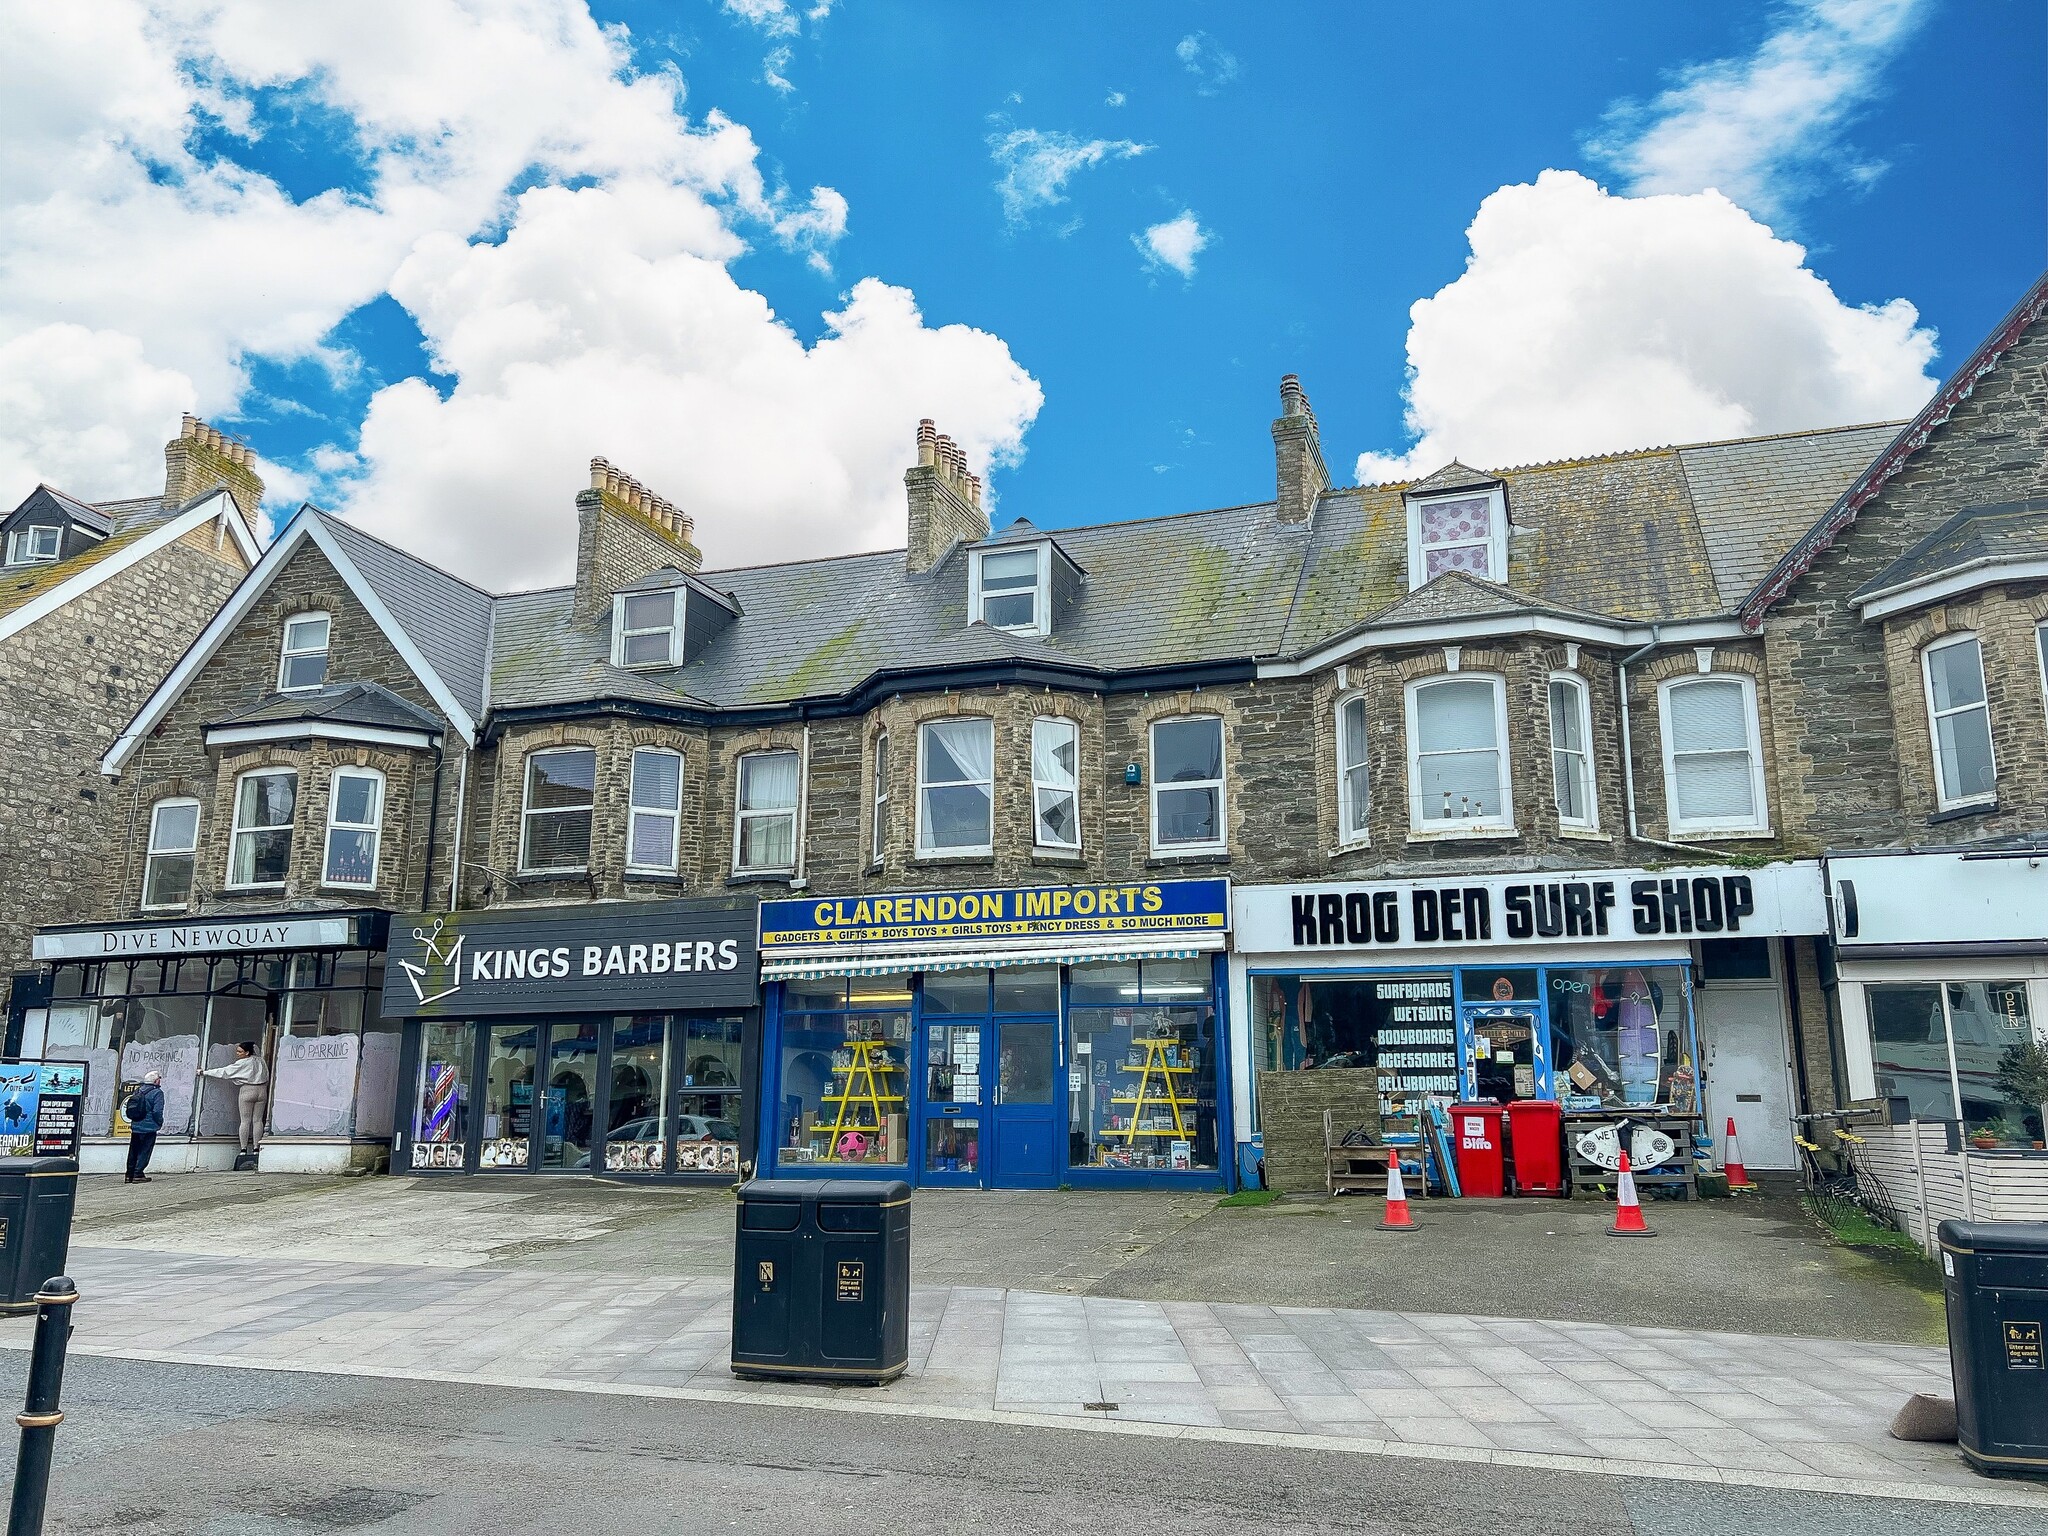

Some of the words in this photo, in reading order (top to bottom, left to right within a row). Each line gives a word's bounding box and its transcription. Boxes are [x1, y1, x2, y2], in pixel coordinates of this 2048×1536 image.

[814, 894, 1003, 926] CLARENDON
[1015, 886, 1163, 917] IMPORTS
[1291, 891, 1399, 945] KROG
[1412, 887, 1491, 941] DEN
[1505, 881, 1616, 938] SURF
[1630, 875, 1754, 934] SHOP
[774, 932, 820, 943] GADGETS
[825, 931, 833, 940] &
[839, 929, 868, 940] GIFTS
[882, 928, 908, 938] BOYS
[911, 926, 937, 936] TOYS
[952, 924, 982, 935] GIRLS
[985, 923, 1012, 933] TOYS
[1027, 921, 1061, 932] FANCY
[1065, 918, 1100, 930] DRESS
[1107, 918, 1115, 928] &
[1121, 917, 1136, 928] SO
[1139, 916, 1173, 927] MUCH
[1176, 915, 1209, 926] MORE
[472, 947, 570, 980] KINGS
[582, 939, 739, 976] BARBERS
[1376, 982, 1451, 999] SURFBOARDS
[1553, 978, 1591, 995] open
[1393, 1006, 1453, 1021] WETSUITS
[2005, 991, 2019, 1028] OPEN
[1377, 1029, 1454, 1045] BODYBOARDS
[129, 1050, 140, 1063] NO
[143, 1050, 184, 1063] PARKING!
[290, 1044, 306, 1058] NO
[308, 1042, 349, 1058] PARKING
[1378, 1053, 1456, 1068] ACCESSORIES
[1378, 1076, 1457, 1091] BELLYBOARDS
[1462, 1137, 1492, 1150] Biffa
[1596, 1152, 1656, 1168] RECCLE
